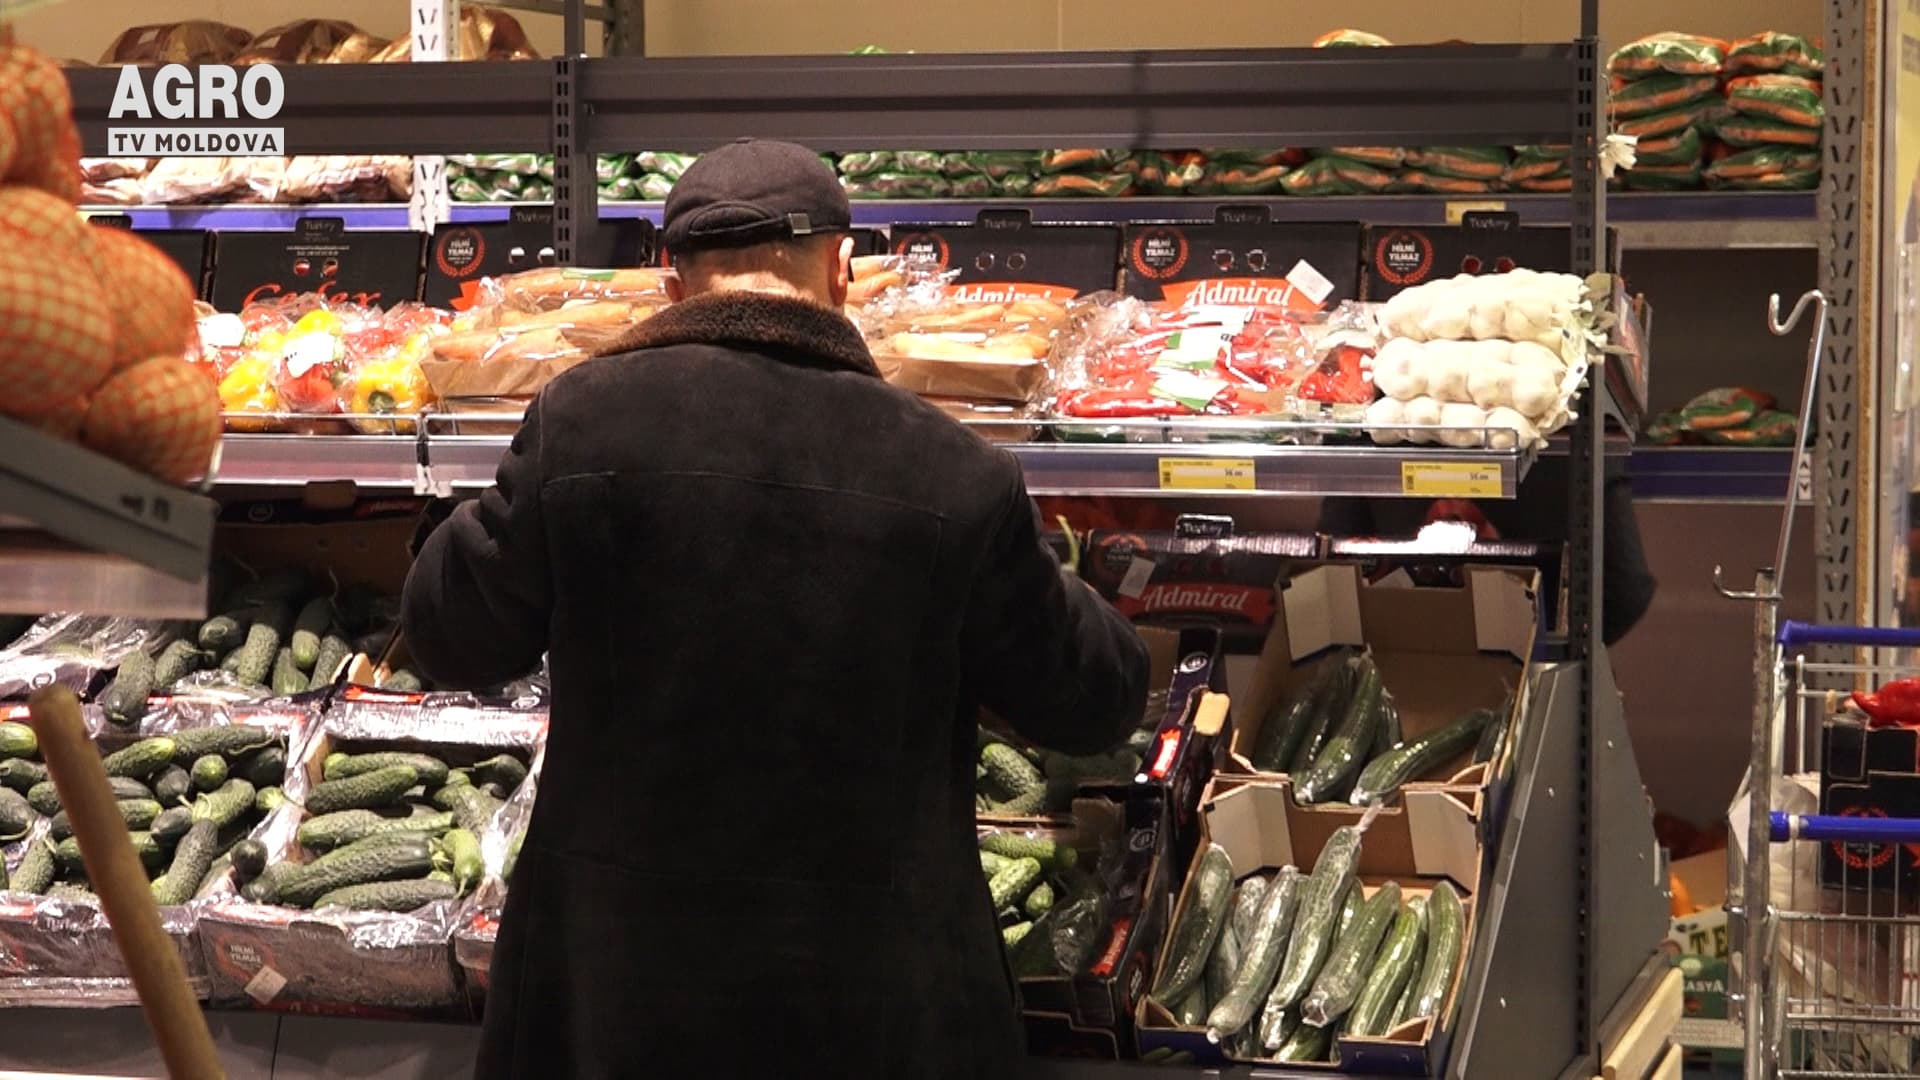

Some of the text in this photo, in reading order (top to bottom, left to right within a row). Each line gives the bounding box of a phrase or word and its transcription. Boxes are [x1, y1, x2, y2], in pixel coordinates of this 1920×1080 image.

[952, 285, 1052, 303] Admi
[1185, 280, 1294, 306] Admiral
[1144, 585, 1250, 612] Admiral
